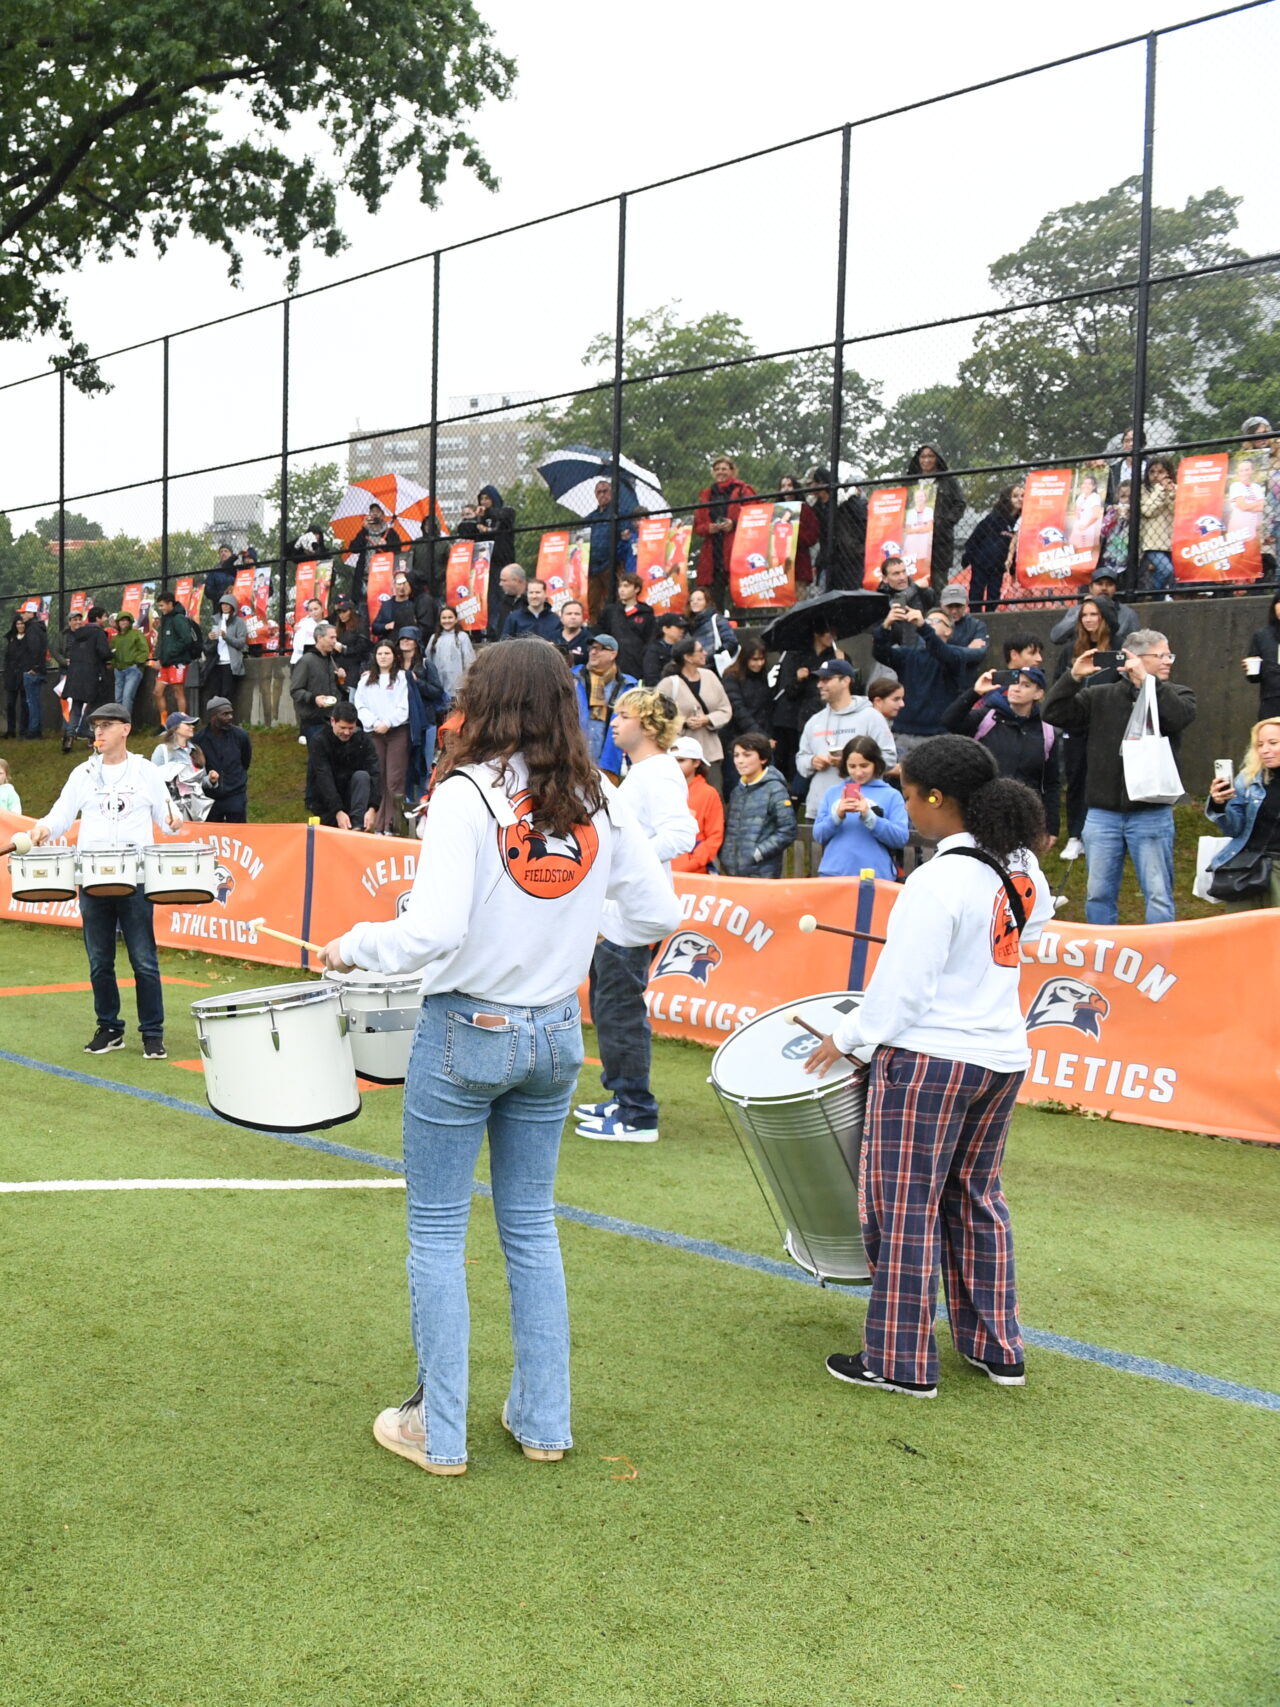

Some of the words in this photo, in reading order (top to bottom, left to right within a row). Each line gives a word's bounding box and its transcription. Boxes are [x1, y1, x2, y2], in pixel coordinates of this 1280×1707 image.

[1181, 527, 1252, 559] CAROLINE
[1038, 544, 1075, 566] RYAN
[739, 565, 785, 587] MORGAN
[1050, 567, 1072, 579] #20
[524, 868, 575, 883] FIELDSTON
[1027, 1049, 1177, 1103] LETICS
